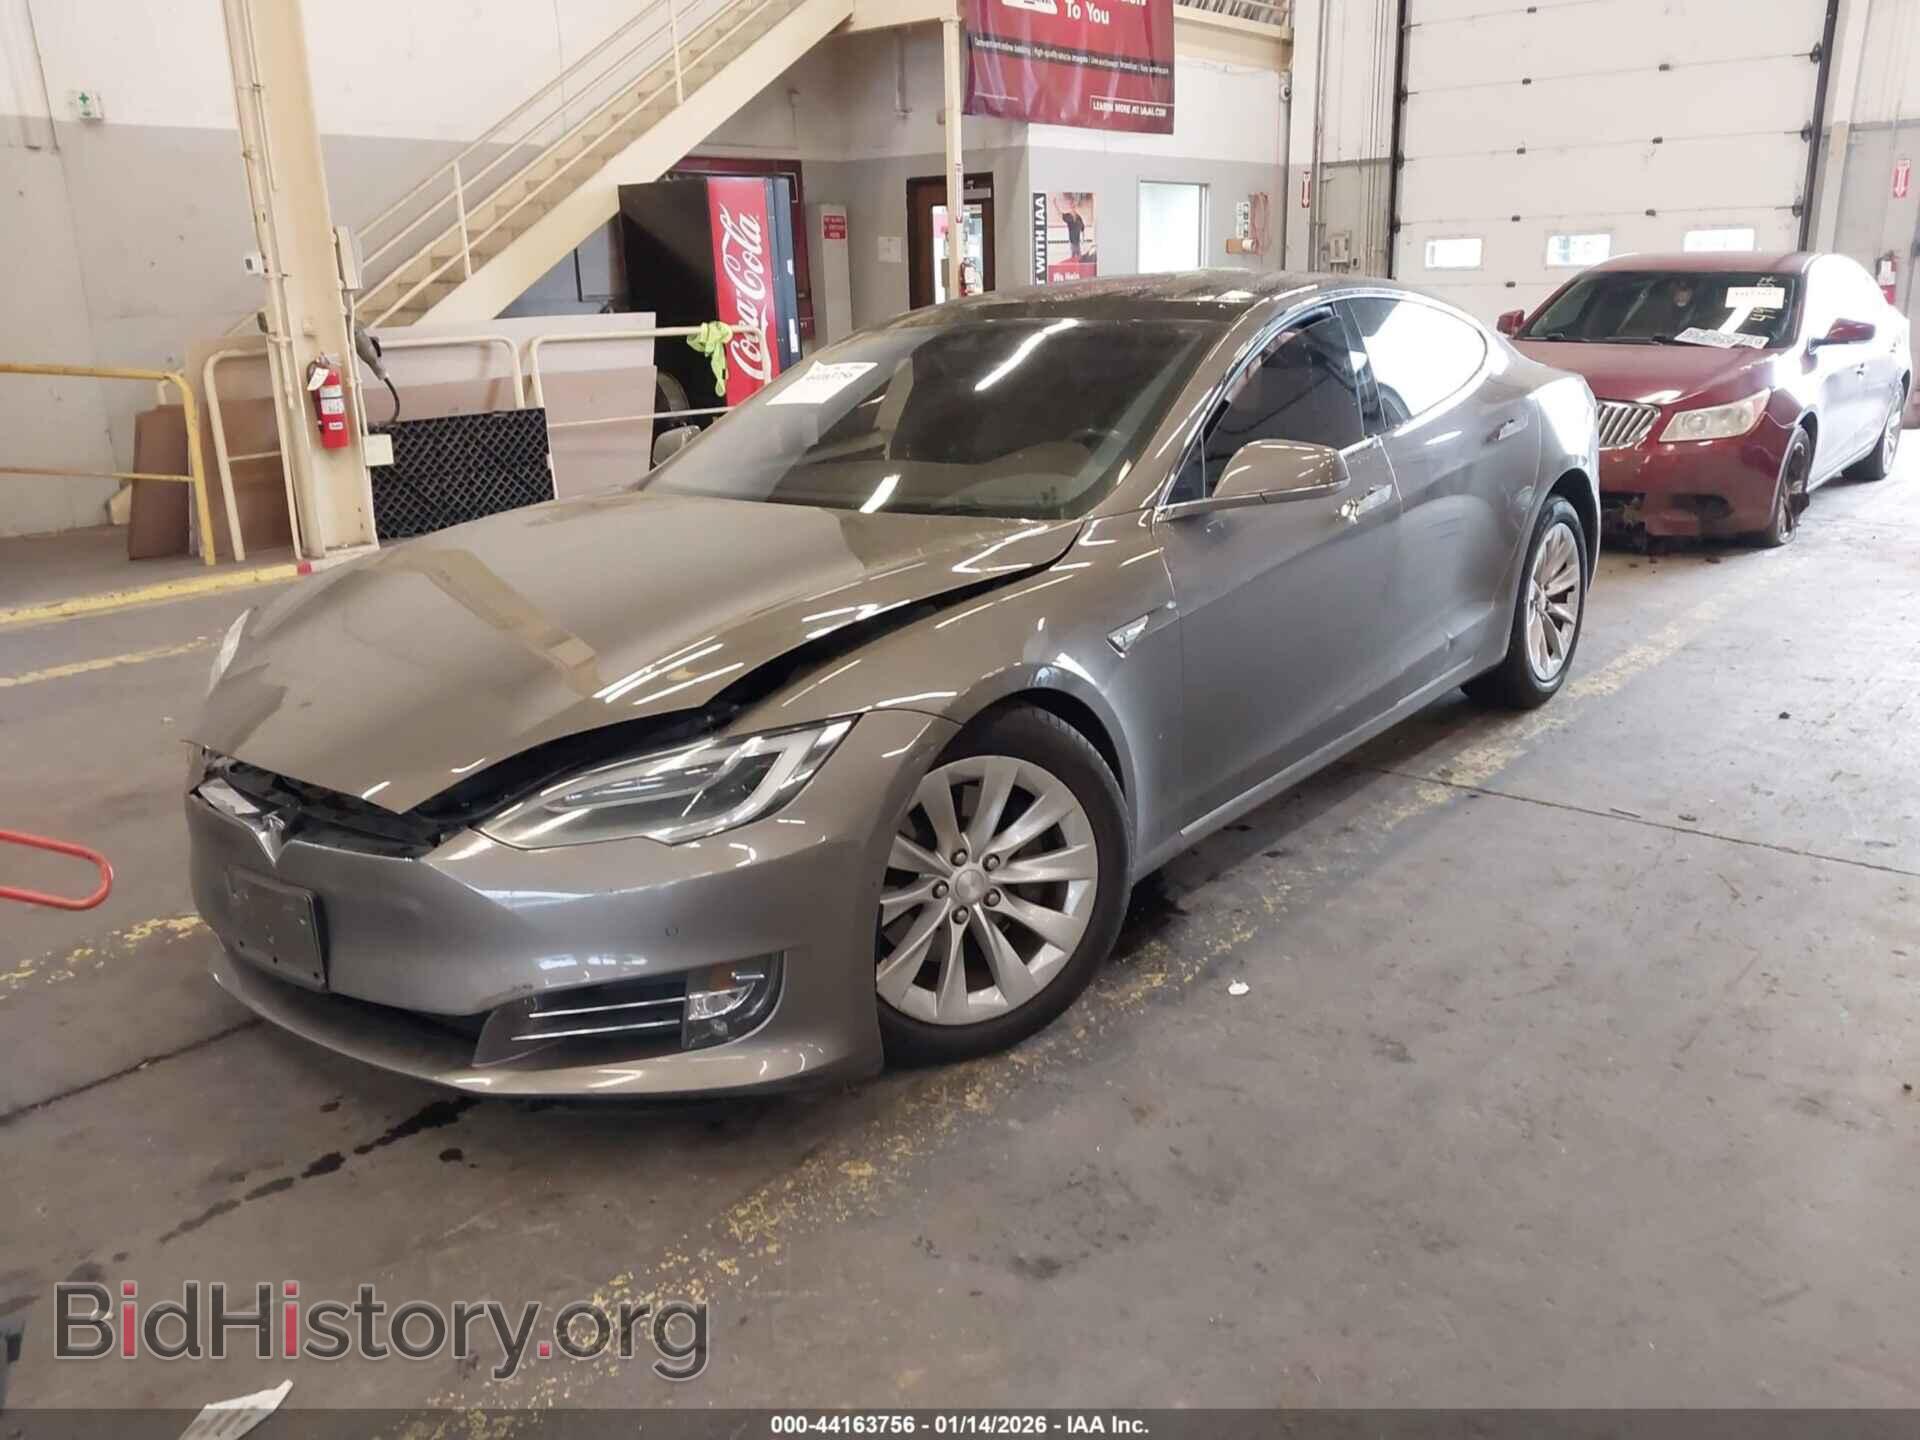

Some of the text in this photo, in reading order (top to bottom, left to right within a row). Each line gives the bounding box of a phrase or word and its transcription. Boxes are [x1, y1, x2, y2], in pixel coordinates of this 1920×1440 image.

[1065, 1, 1081, 19] To
[1086, 3, 1109, 25] You
[1035, 197, 1045, 225] IAA
[1036, 230, 1045, 273] WITH
